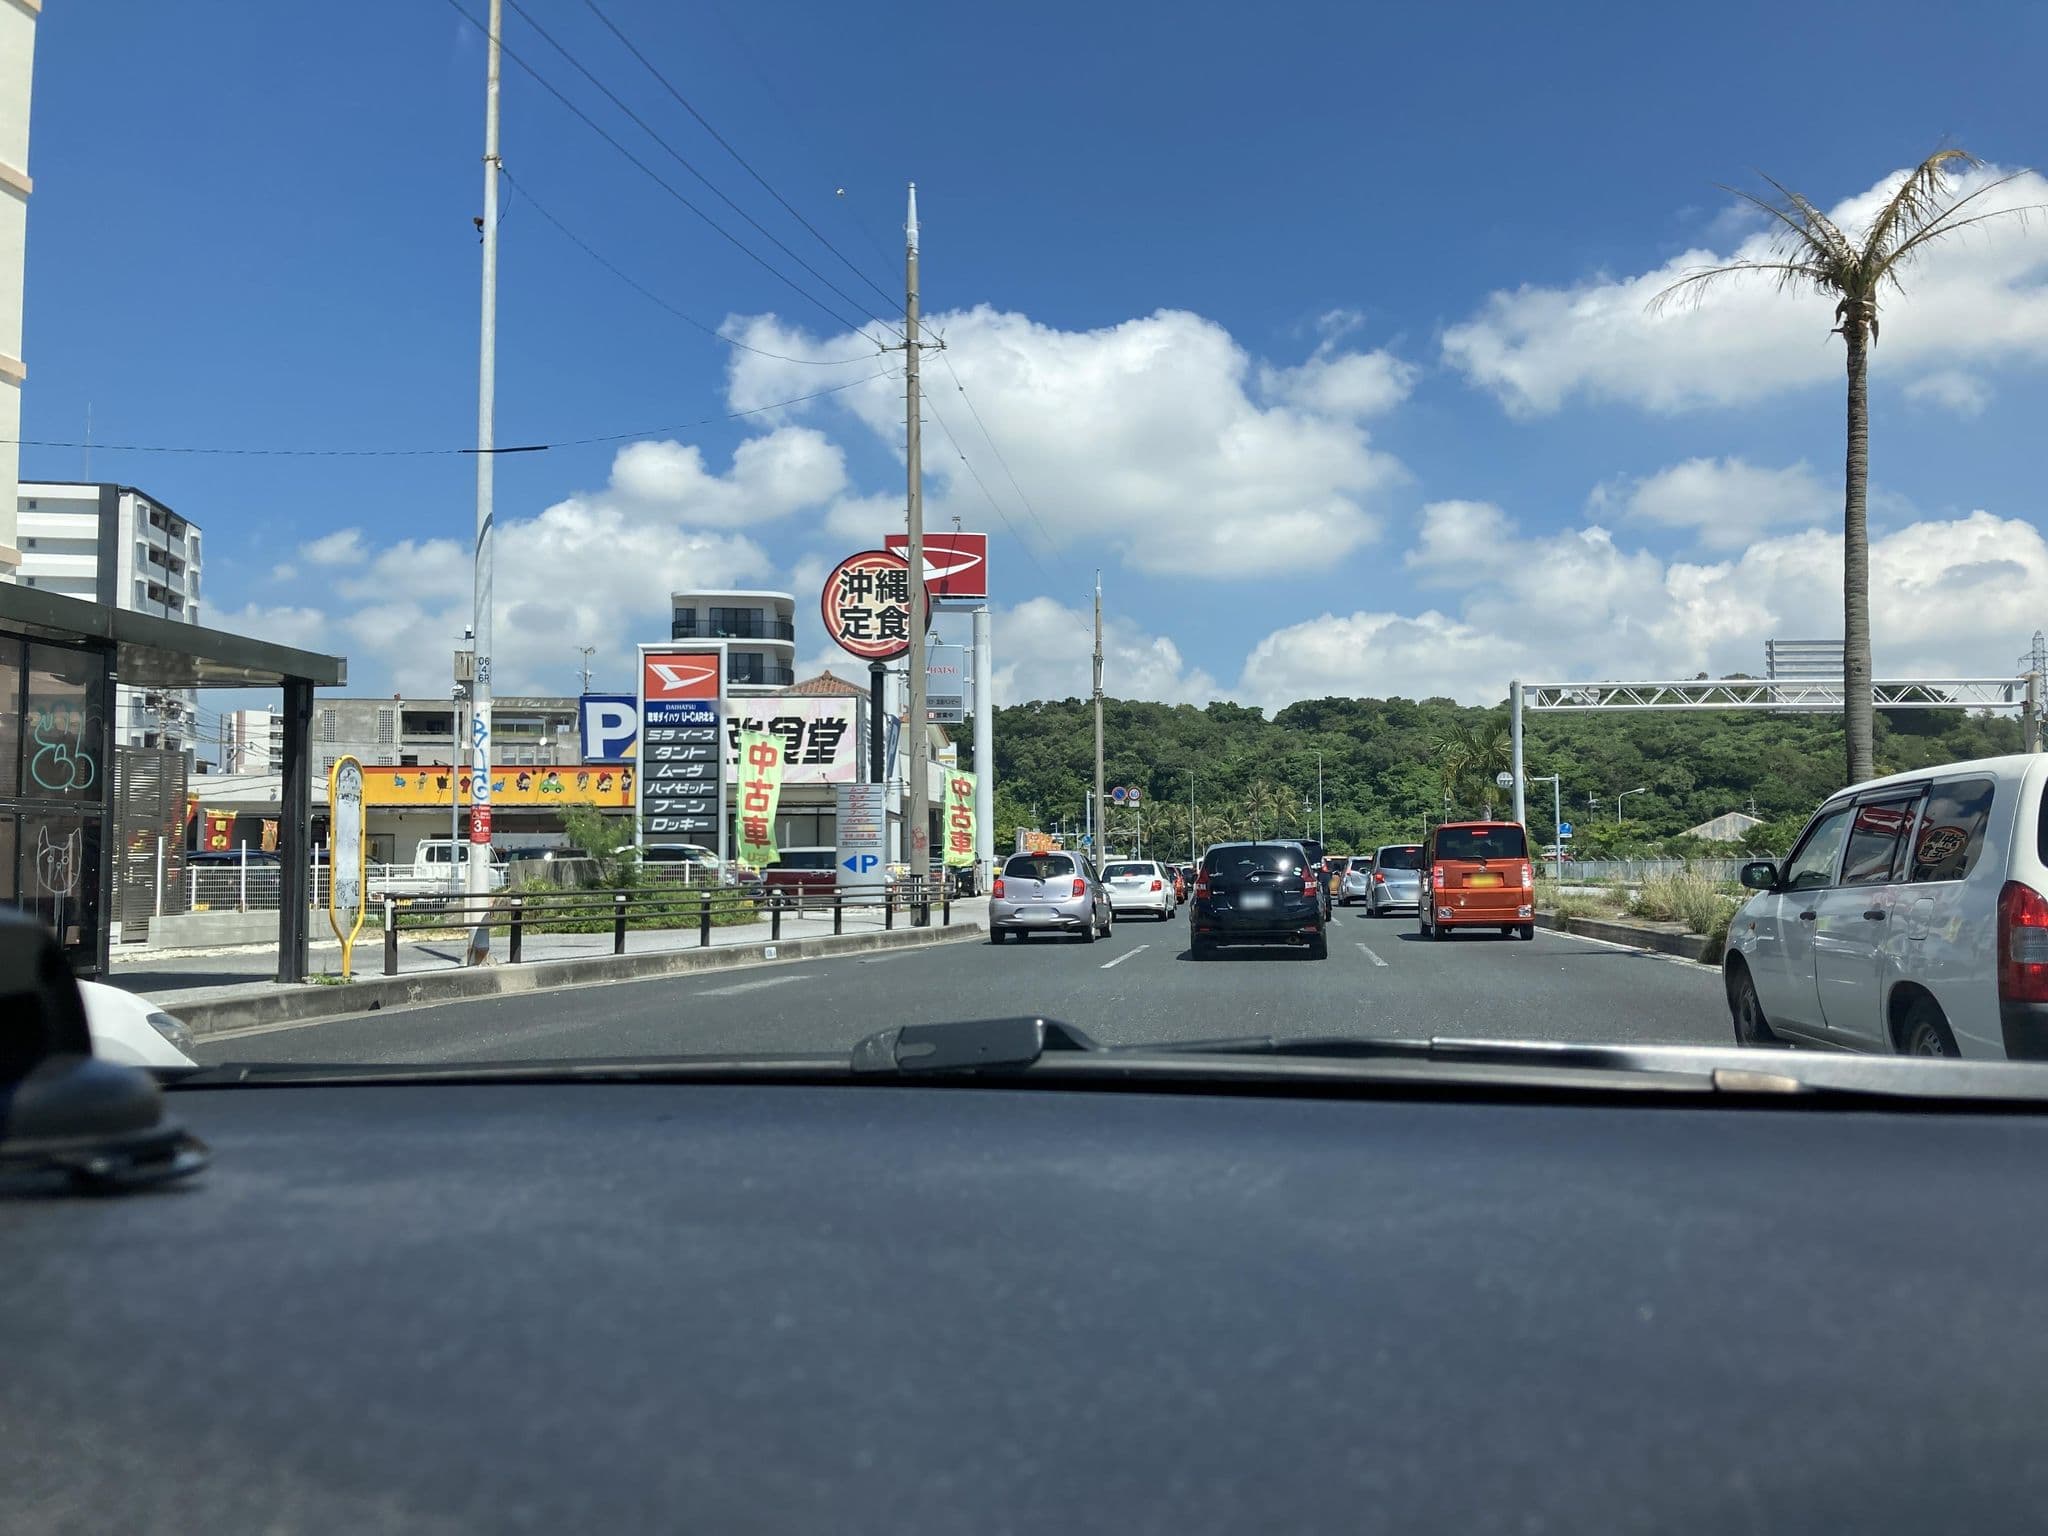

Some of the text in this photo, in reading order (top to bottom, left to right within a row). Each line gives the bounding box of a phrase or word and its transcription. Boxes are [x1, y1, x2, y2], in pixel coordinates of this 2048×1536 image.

[839, 568, 909, 603] 沖縄
[839, 605, 909, 640] 定食
[481, 666, 487, 674] 4
[585, 702, 637, 758] P
[655, 746, 707, 760] タント
[656, 763, 705, 778] ムーヴ
[646, 783, 715, 795] ハイゼット
[742, 741, 778, 850] 中古車
[653, 799, 706, 813] ブーン
[650, 817, 709, 831] ロッキー
[950, 776, 973, 855] 中古車
[861, 854, 879, 874] P
